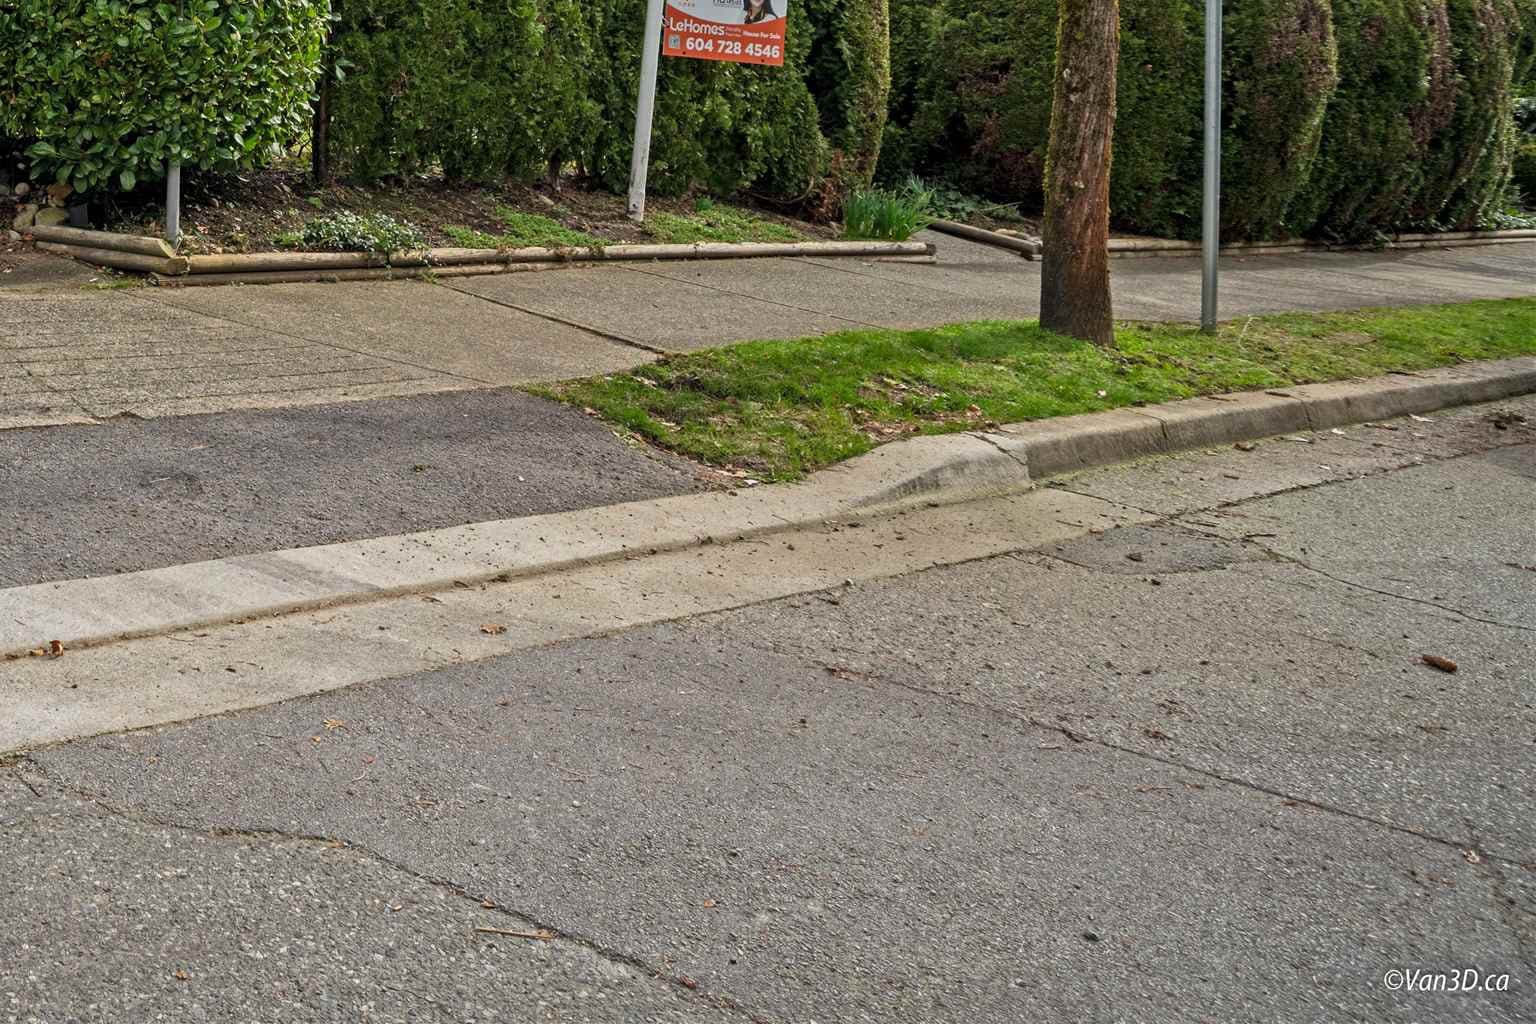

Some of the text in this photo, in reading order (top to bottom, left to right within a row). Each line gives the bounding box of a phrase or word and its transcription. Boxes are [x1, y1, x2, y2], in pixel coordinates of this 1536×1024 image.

[670, 17, 725, 36] LeHomes
[686, 37, 781, 59] 604 728 4546
